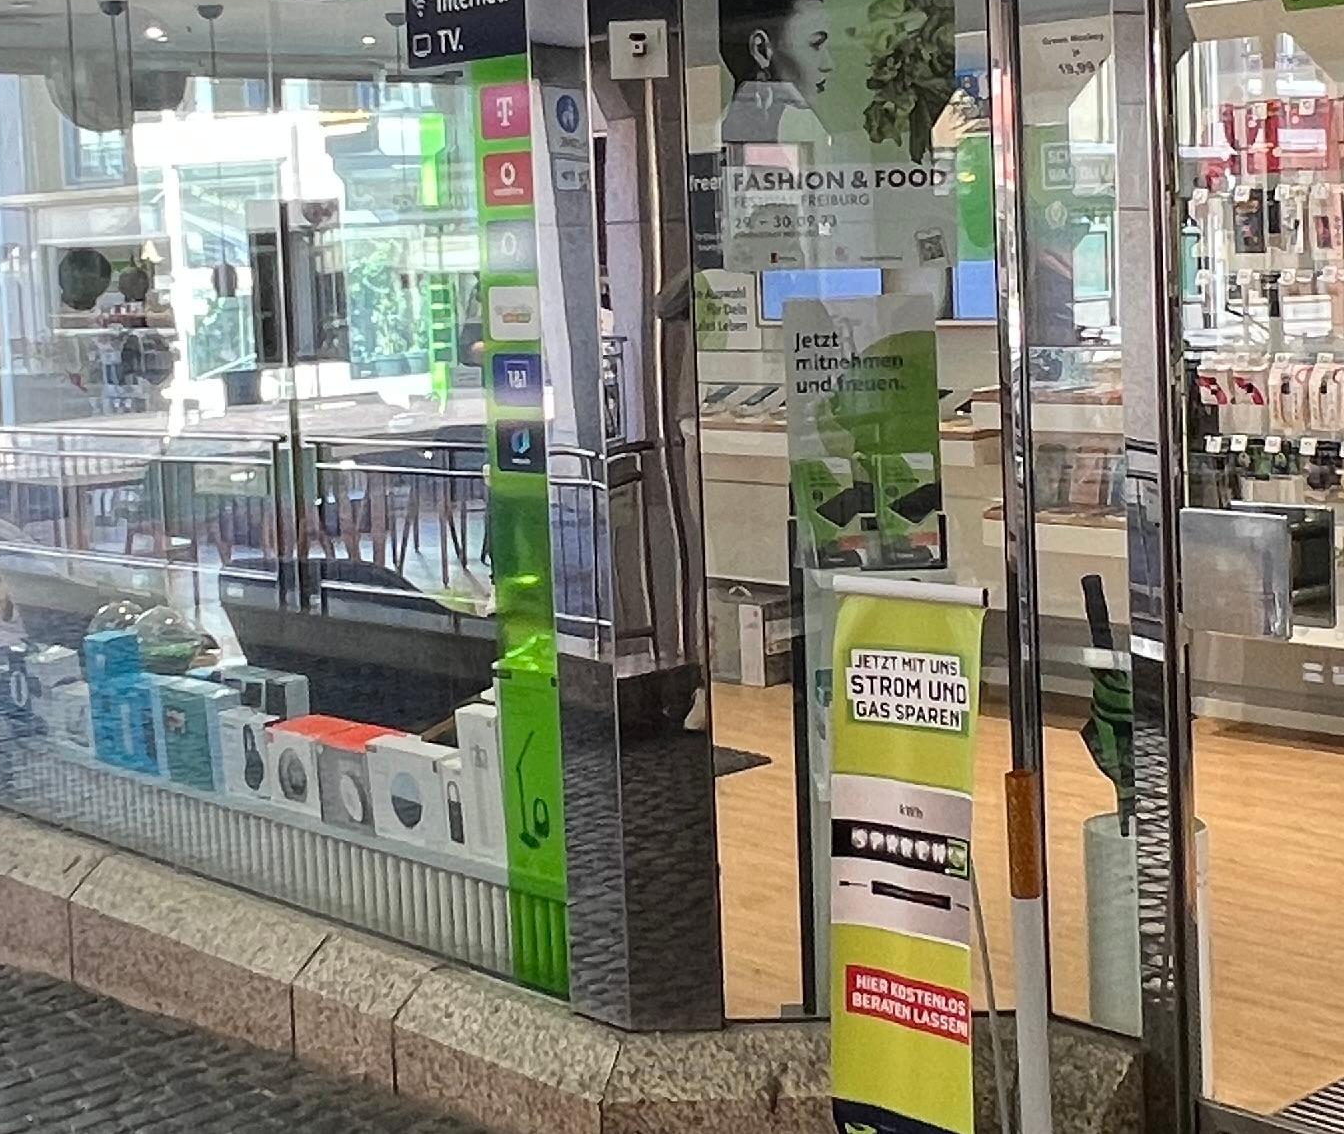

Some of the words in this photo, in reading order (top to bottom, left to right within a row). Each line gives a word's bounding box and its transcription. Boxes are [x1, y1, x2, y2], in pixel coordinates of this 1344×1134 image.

[437, 27, 464, 54] TV.
[496, 96, 513, 127] T
[733, 171, 845, 192] FASHION
[850, 170, 869, 188] &
[874, 168, 947, 189] FOOD
[801, 193, 870, 208] FREIBURG
[794, 331, 839, 353] Jetzt
[796, 352, 904, 372] mitnehmen
[796, 376, 832, 394] und
[836, 375, 906, 393] freuen.
[855, 654, 898, 671] JETZT
[902, 657, 926, 673] MIT
[930, 660, 958, 676] UNS
[851, 674, 922, 700] STROM
[928, 680, 967, 704] UND
[856, 701, 890, 718] GAS
[895, 703, 960, 728] SPAREN
[899, 804, 924, 819] kWh
[852, 991, 912, 1021] BERATEN
[856, 974, 889, 994] HIER
[890, 981, 966, 1016] KOSTENLOS
